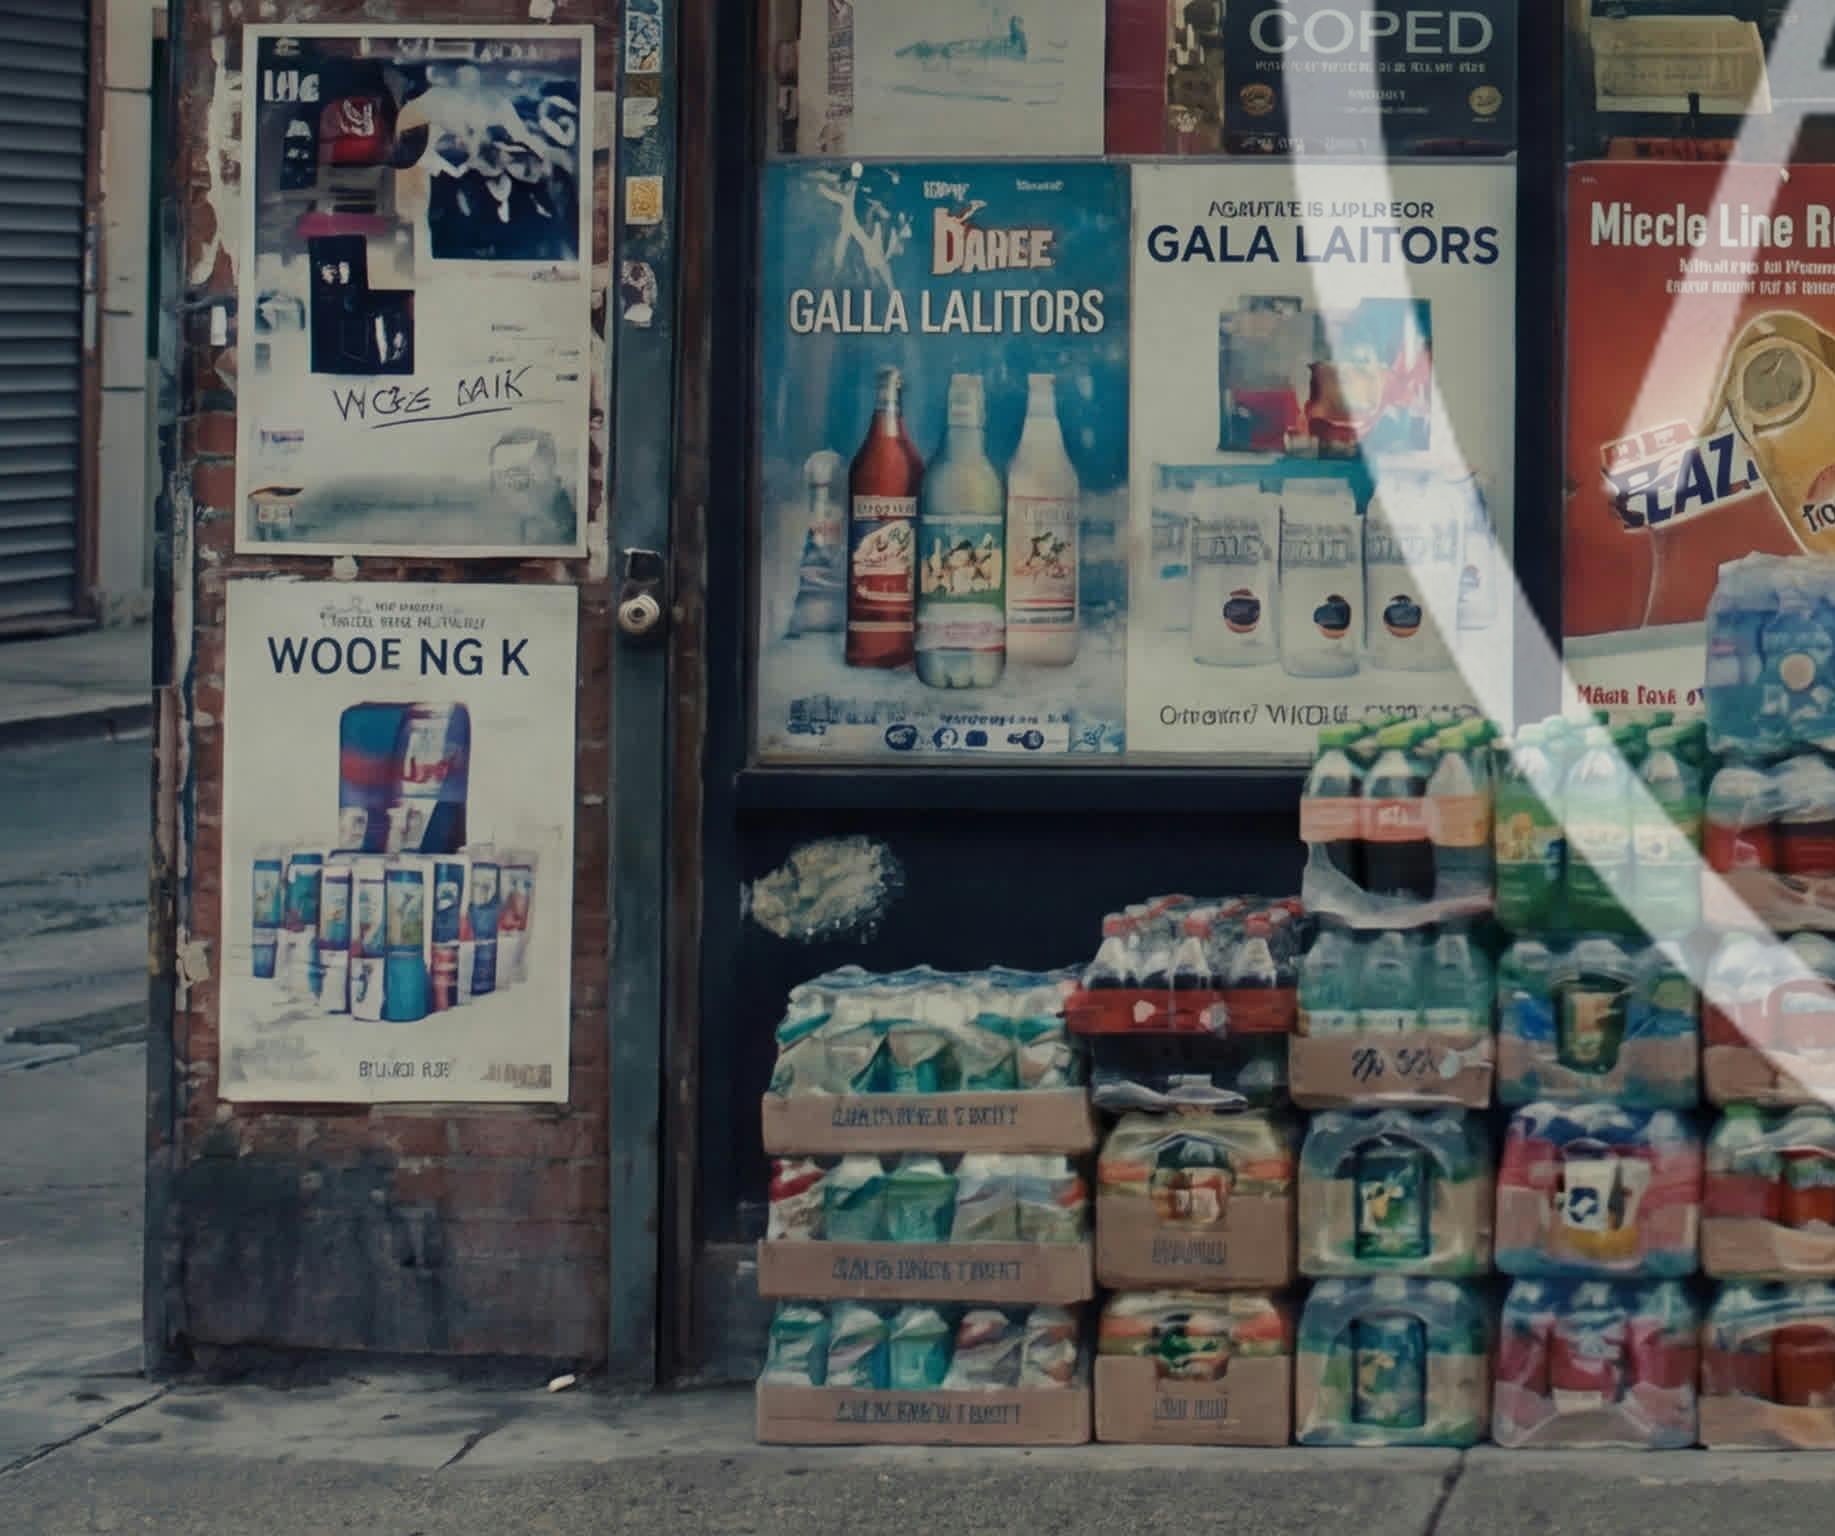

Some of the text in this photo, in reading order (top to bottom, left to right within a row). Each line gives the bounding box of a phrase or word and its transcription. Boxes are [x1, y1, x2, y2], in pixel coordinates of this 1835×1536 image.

[1249, 8, 1494, 55] COPED
[1147, 223, 1501, 265] GALA LAITORS
[1718, 203, 1794, 248] Line
[788, 287, 1105, 335] GALLA LALITORS
[267, 636, 530, 677] WOOE NG K
